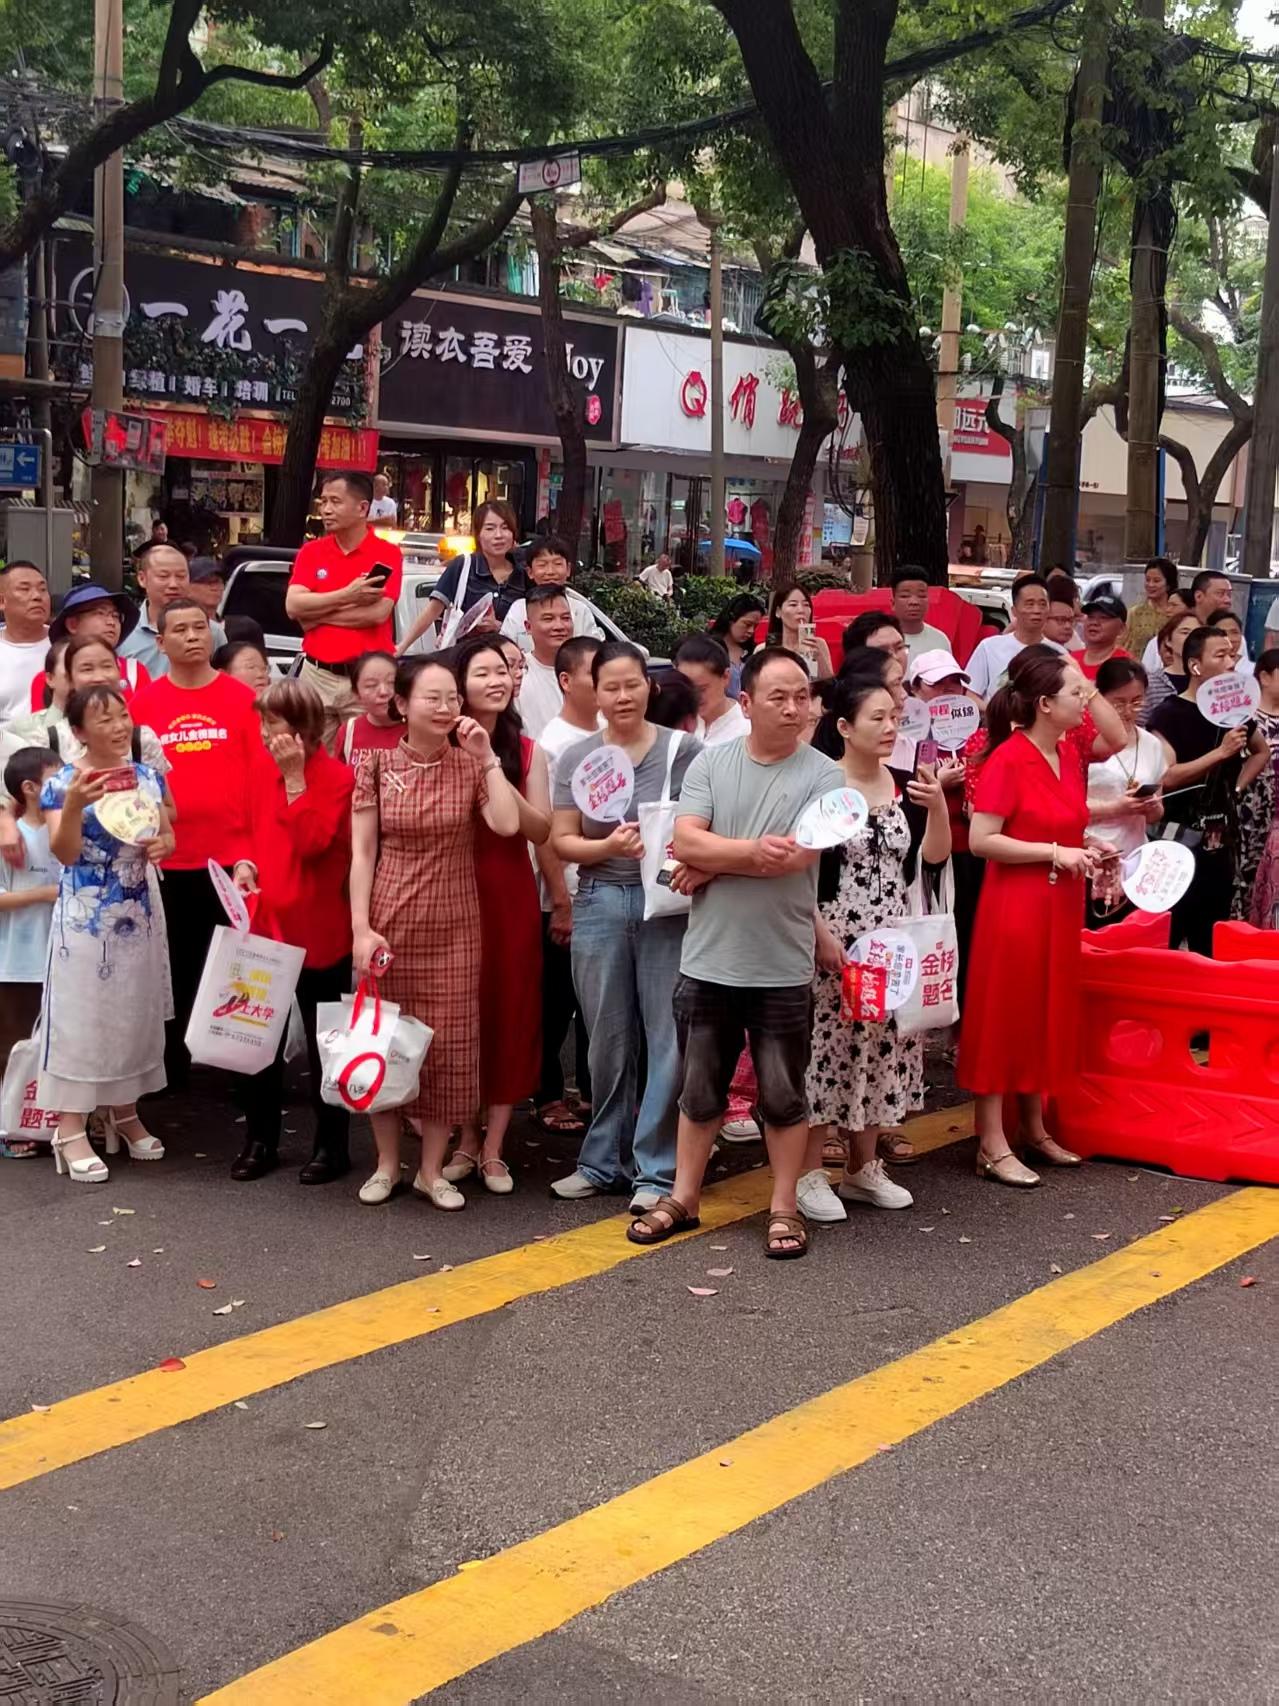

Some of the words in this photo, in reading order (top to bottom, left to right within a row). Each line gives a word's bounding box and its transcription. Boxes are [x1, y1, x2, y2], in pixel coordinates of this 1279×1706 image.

[400, 320, 533, 375] 读衣吾爱
[282, 389, 297, 401] TEL
[921, 978, 953, 1008] 题名
